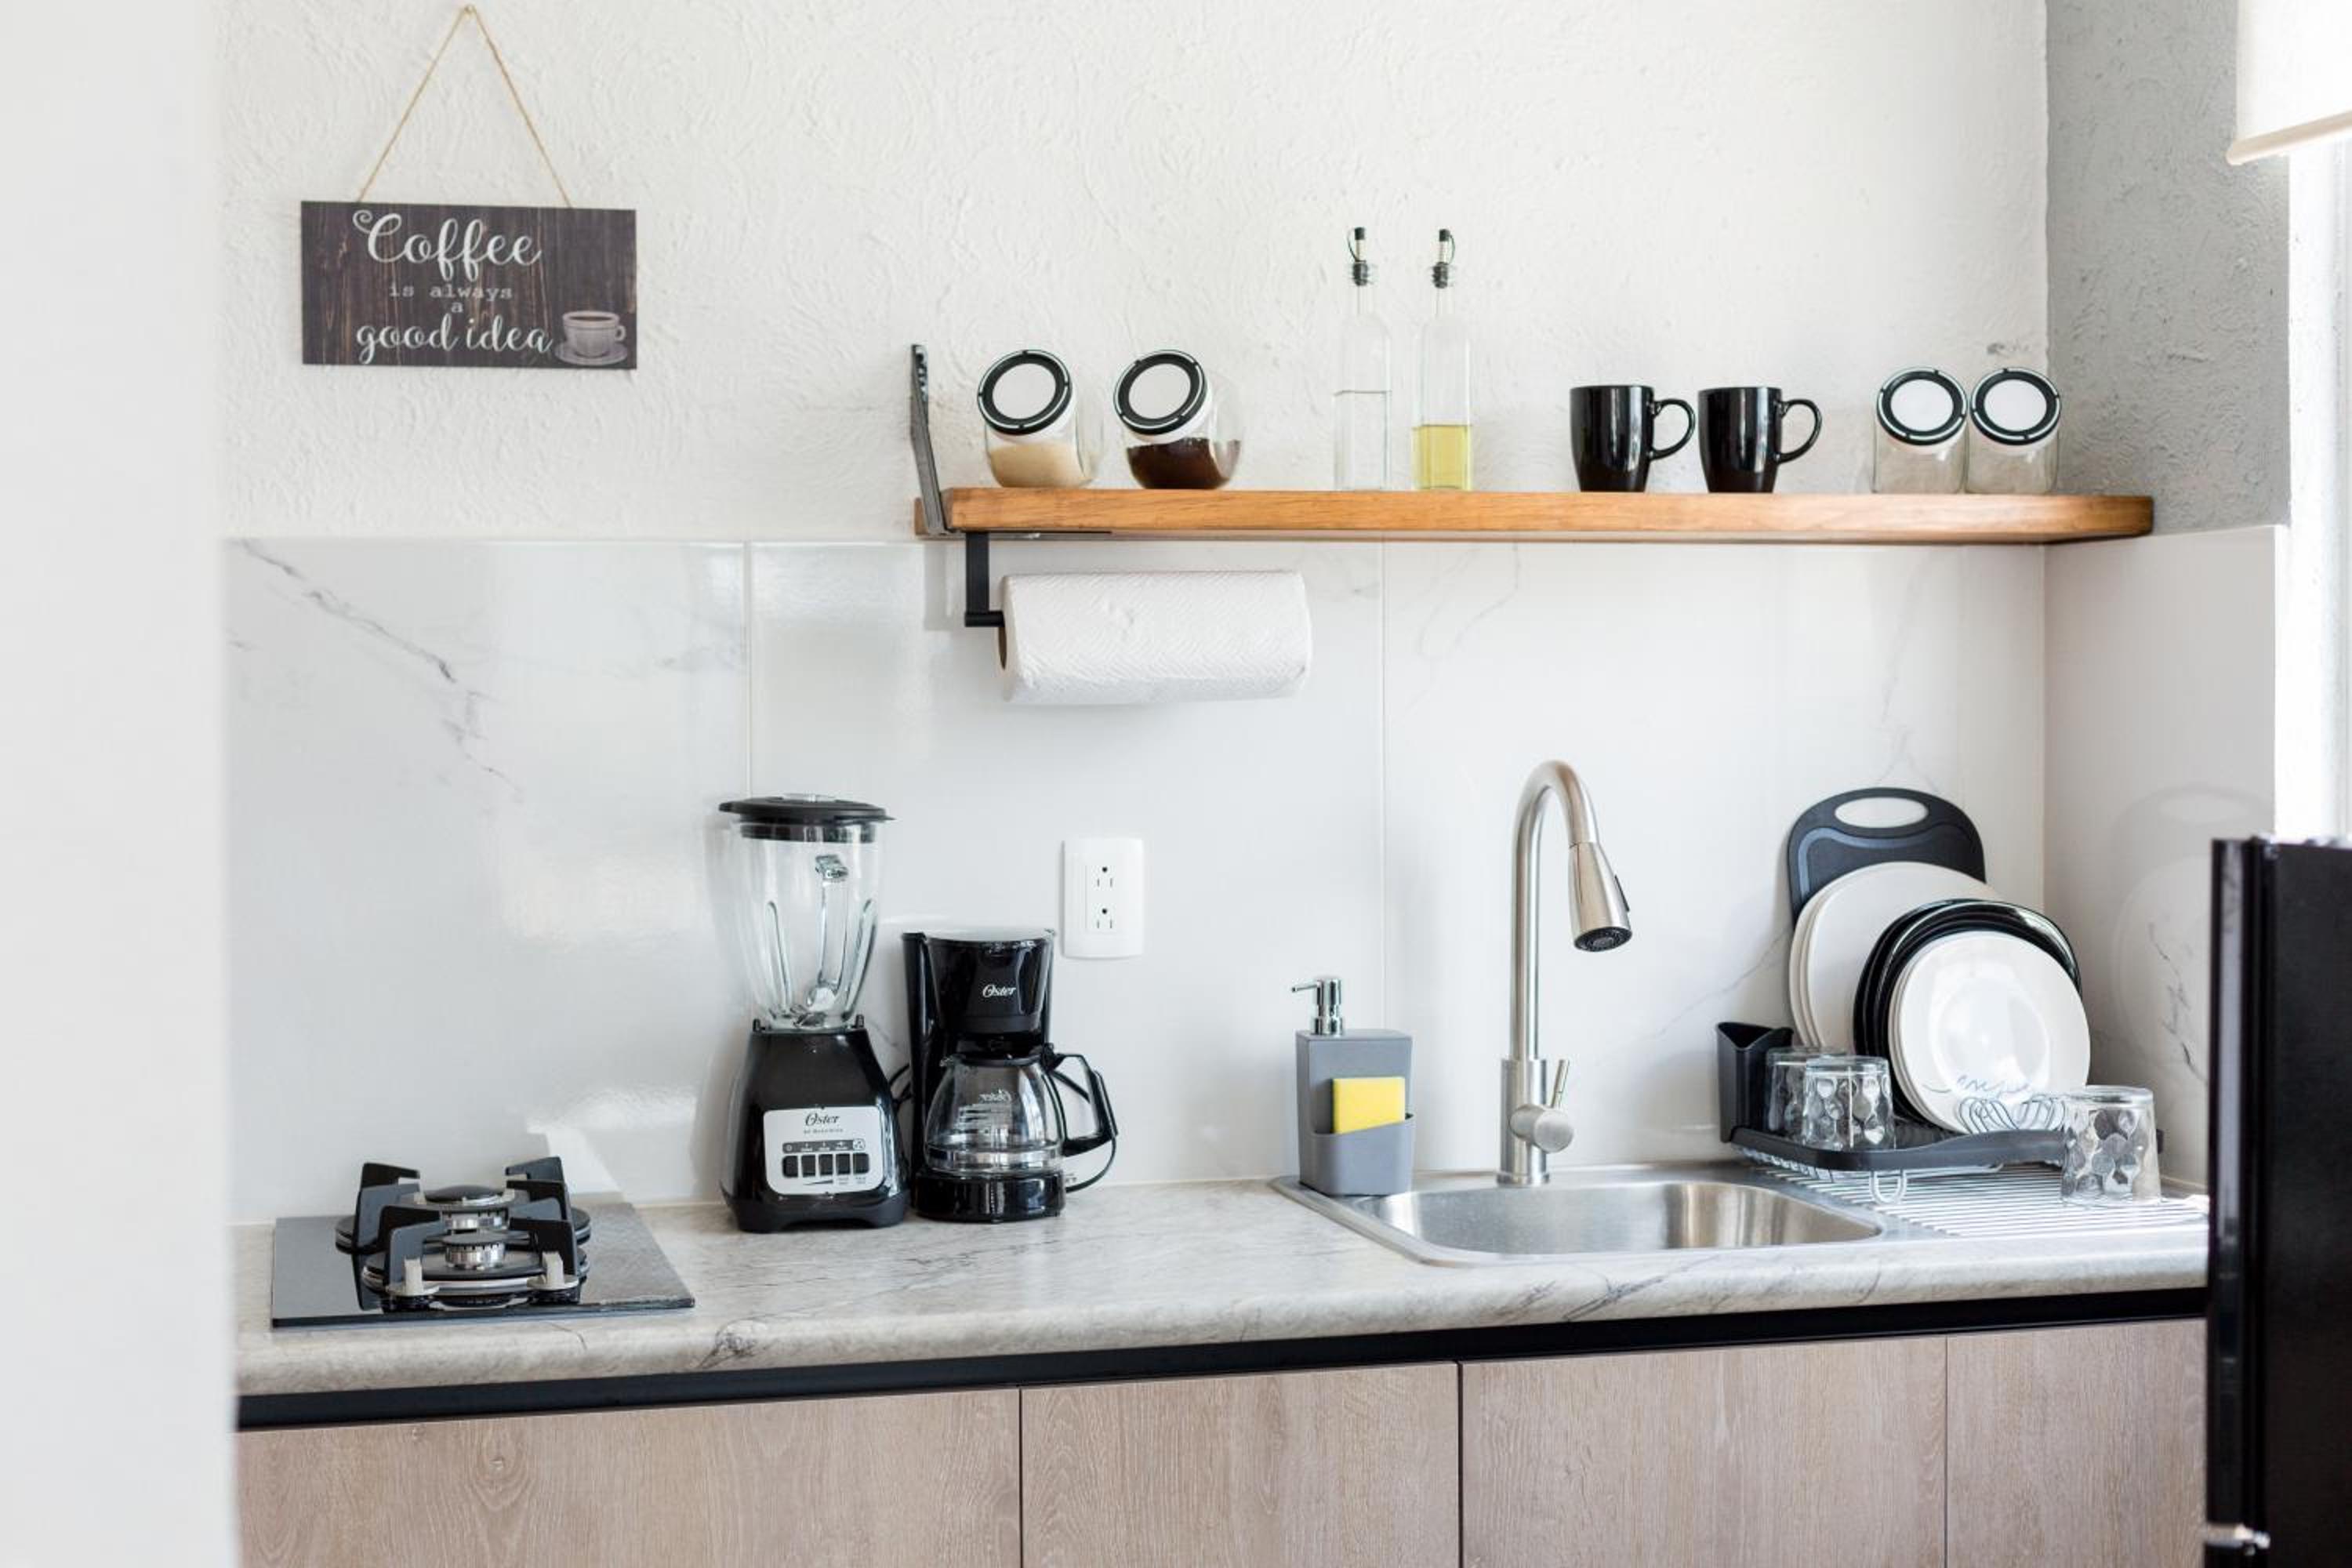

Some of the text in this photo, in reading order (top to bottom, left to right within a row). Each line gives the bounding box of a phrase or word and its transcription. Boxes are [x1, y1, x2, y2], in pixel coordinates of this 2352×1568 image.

[353, 209, 542, 281] Coffee
[390, 284, 513, 301] is always
[451, 303, 464, 313] a
[357, 314, 554, 365] good idea
[982, 984, 1017, 998] Oster
[805, 1112, 840, 1126] Oster
